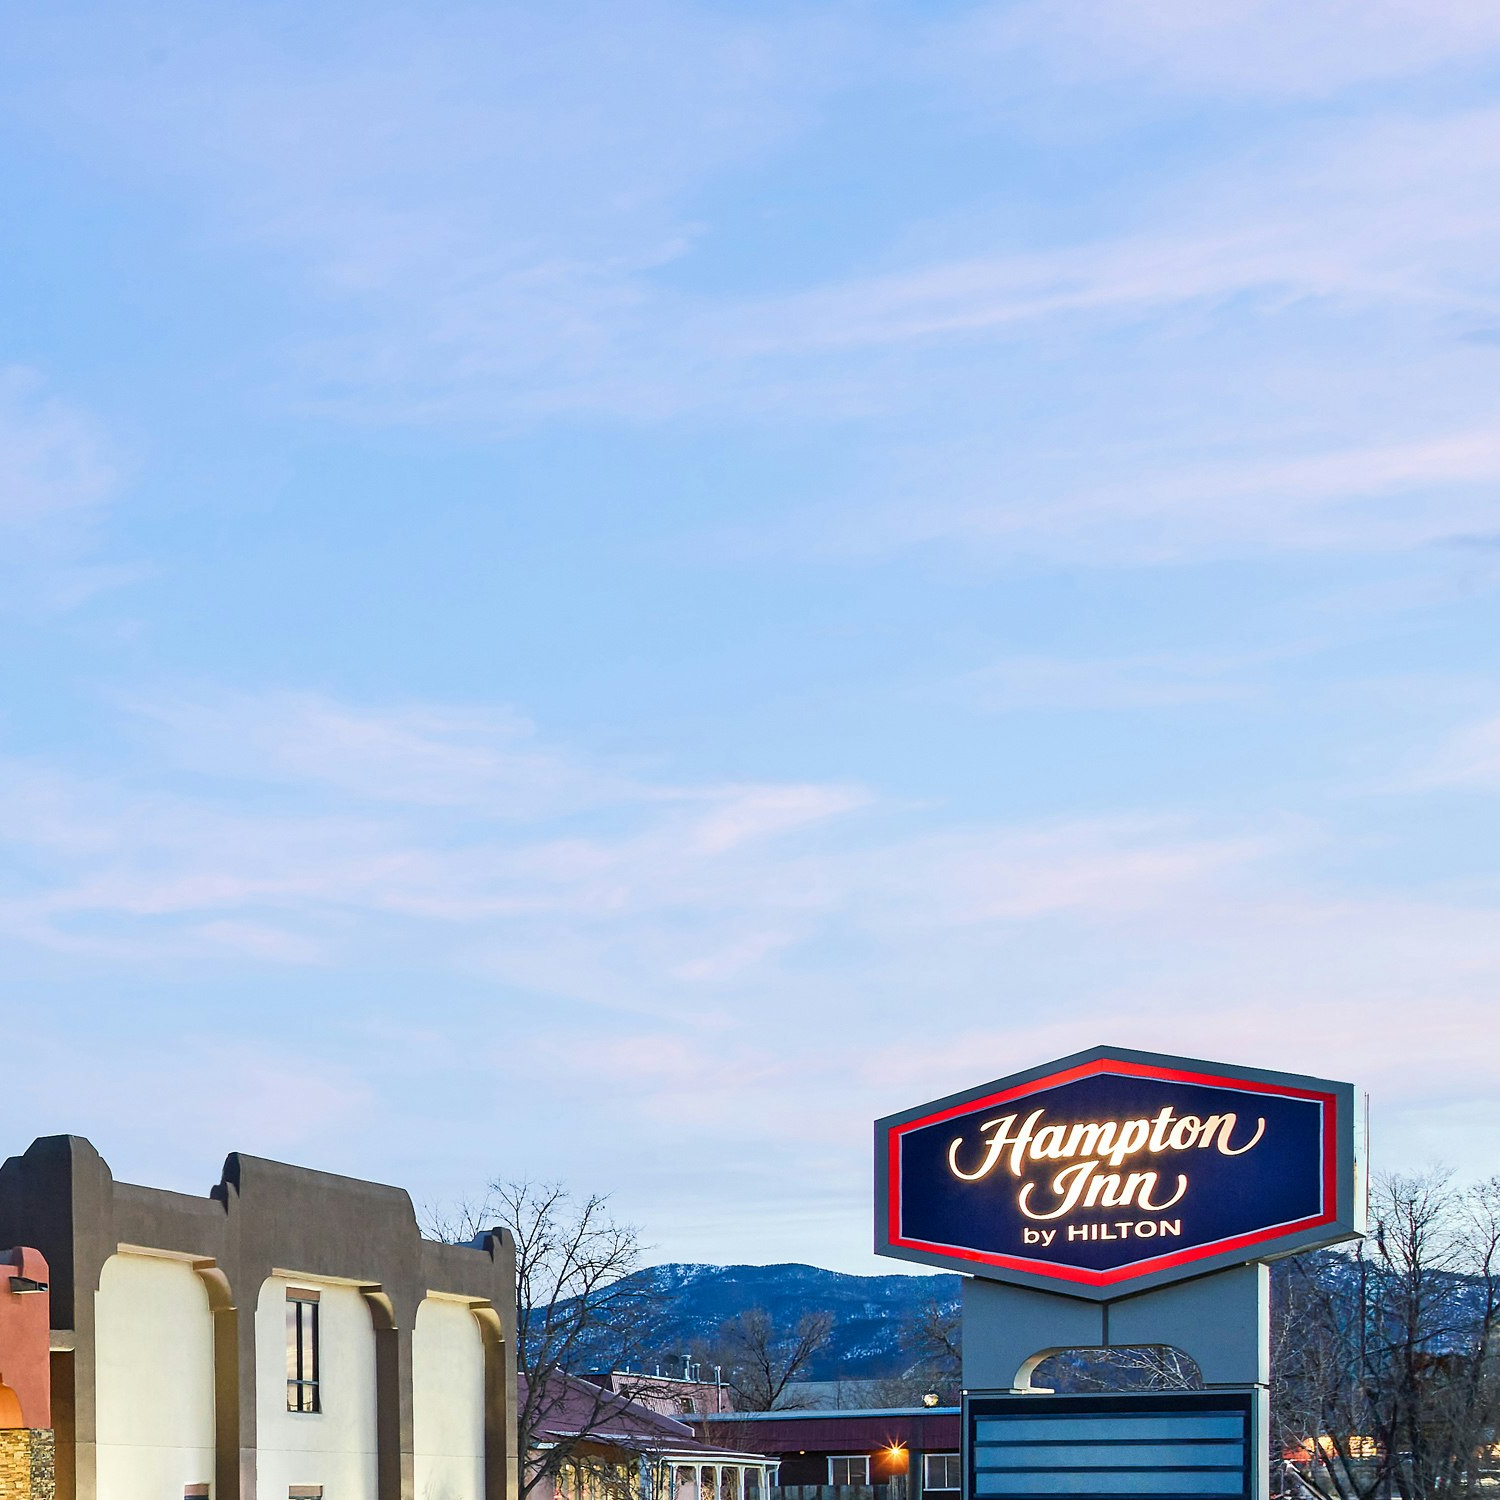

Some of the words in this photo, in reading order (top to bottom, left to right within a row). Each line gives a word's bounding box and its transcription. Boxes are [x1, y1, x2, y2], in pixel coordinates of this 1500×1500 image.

[949, 1106, 1266, 1181] Hampton
[1019, 1158, 1188, 1220] Inn
[1023, 1227, 1057, 1247] by
[1068, 1219, 1181, 1242] HILTON
